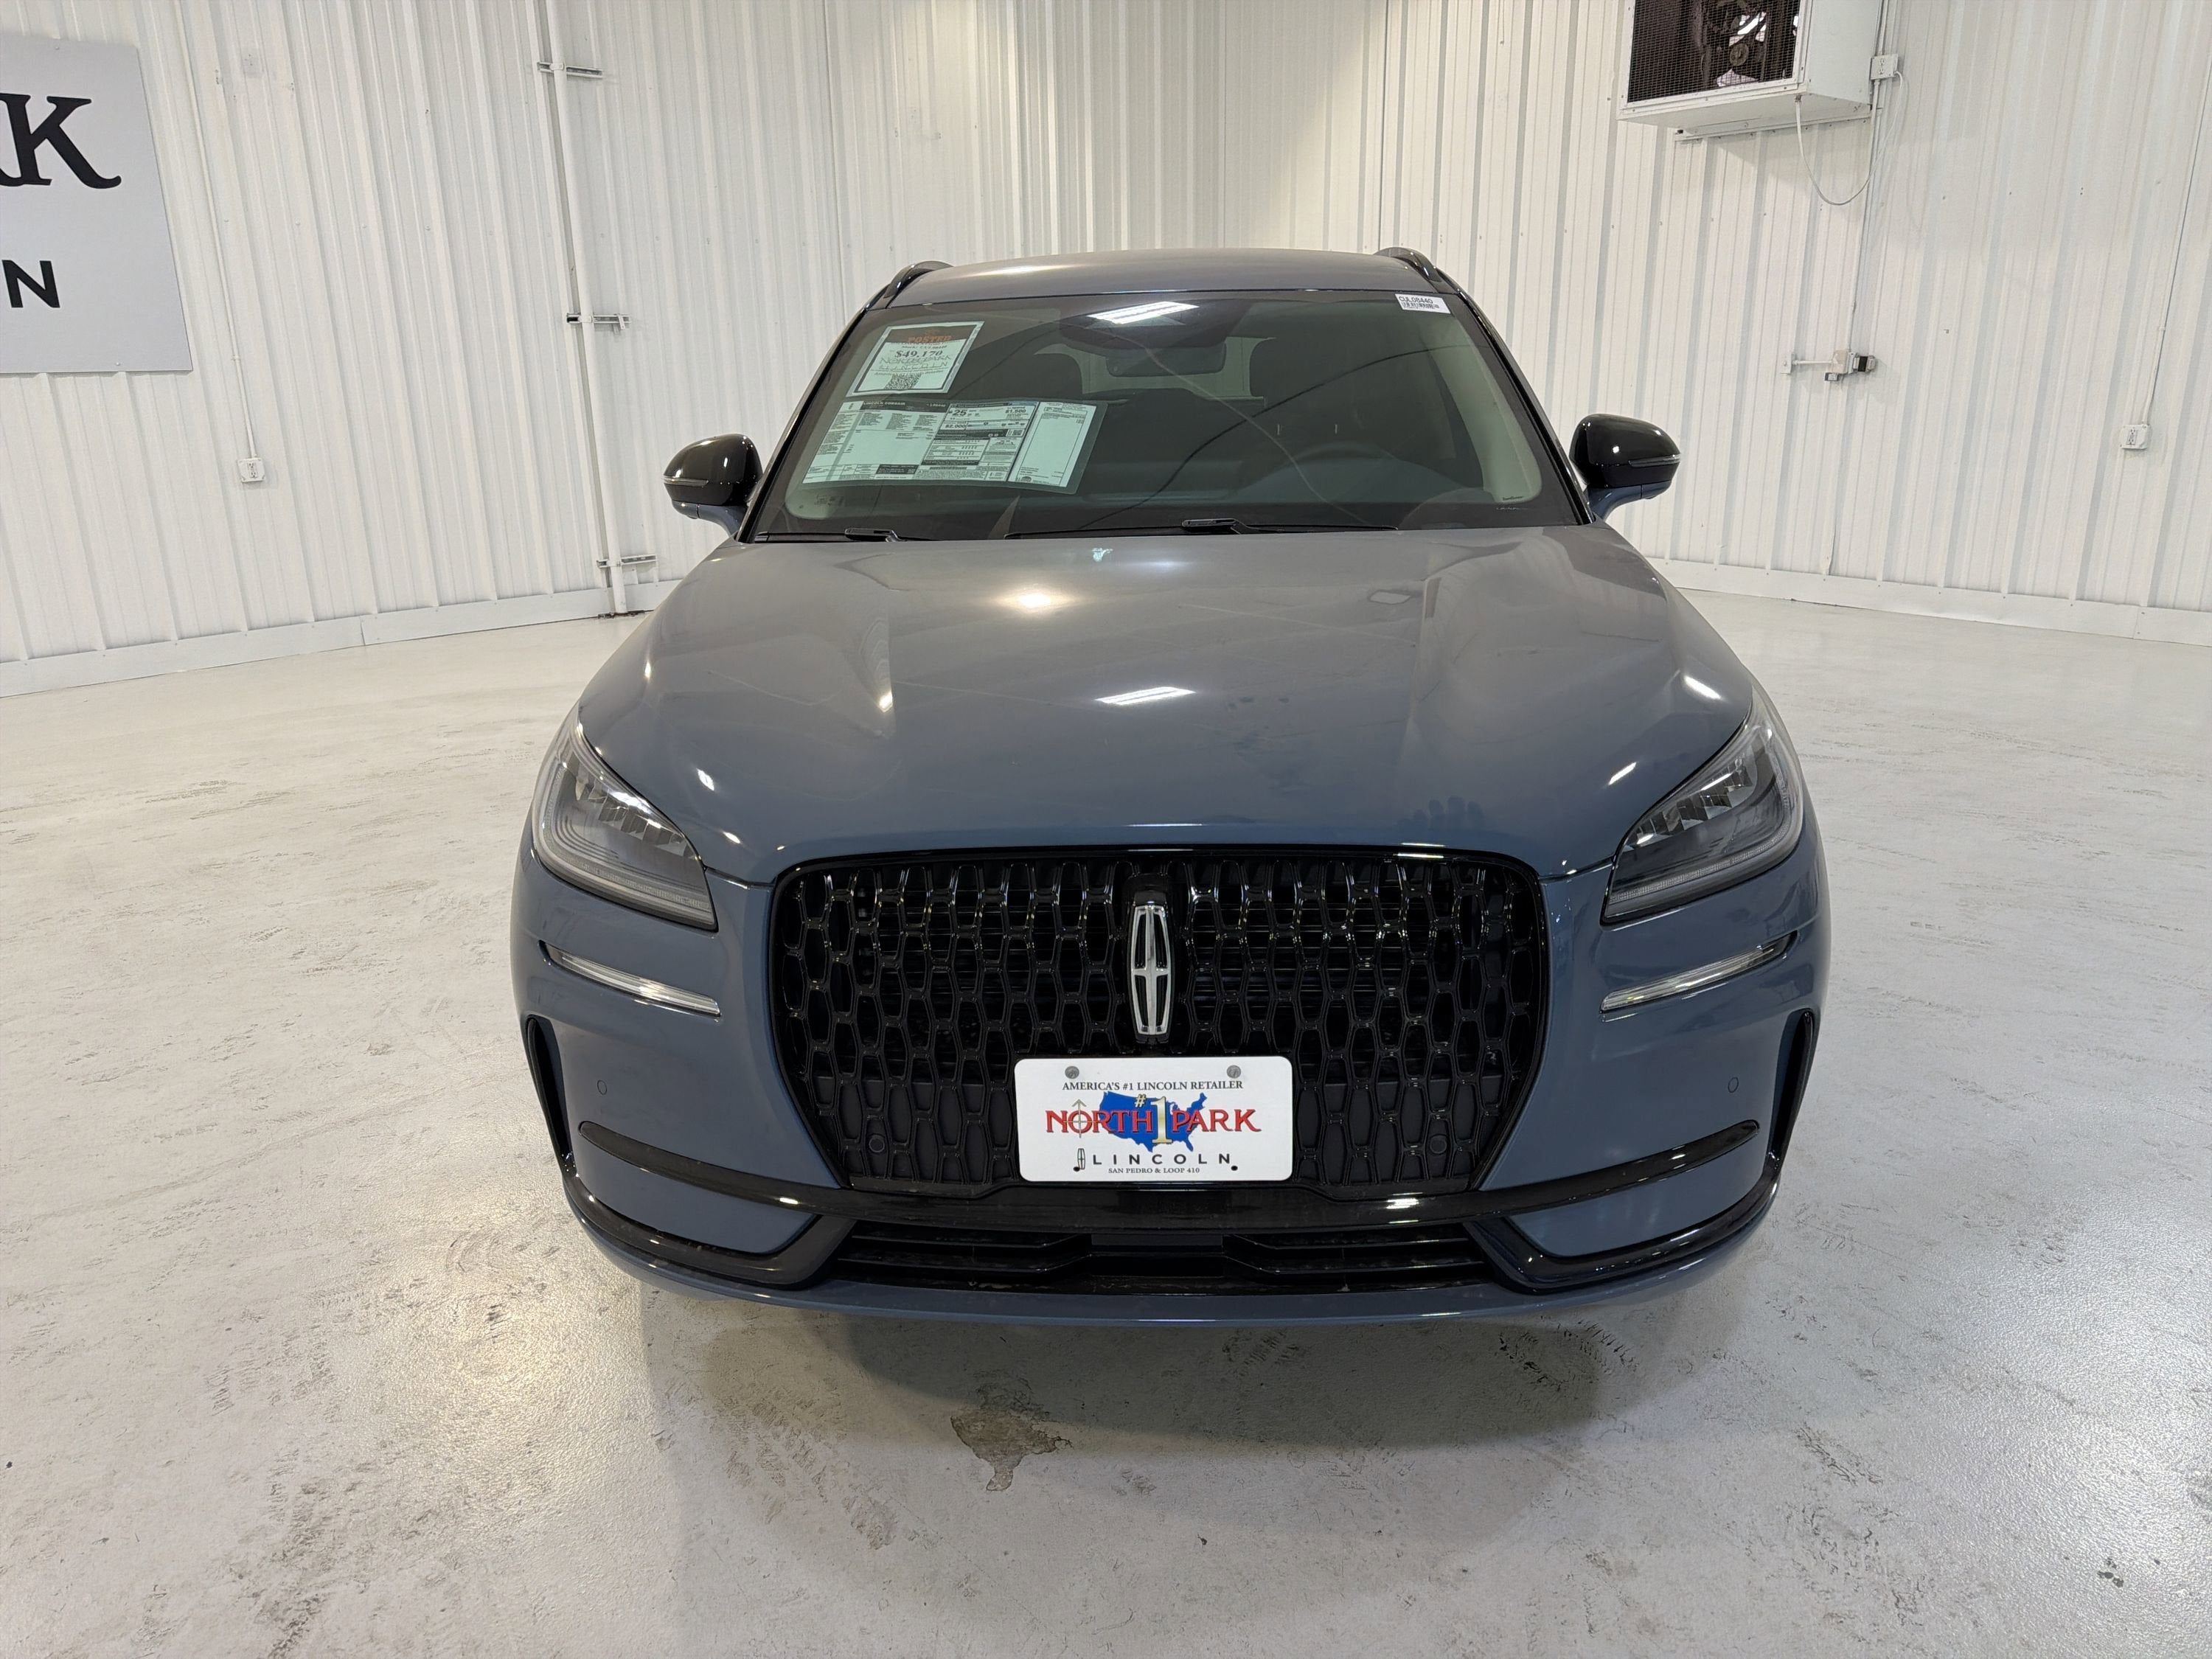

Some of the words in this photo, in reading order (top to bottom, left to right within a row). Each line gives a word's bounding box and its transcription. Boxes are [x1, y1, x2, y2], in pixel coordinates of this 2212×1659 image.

[1062, 1081, 1120, 1091] AMERICA'S
[1123, 1082, 1133, 1091] #1
[1136, 1082, 1187, 1091] LINCOLN
[1191, 1080, 1243, 1090] RETAILER
[1045, 1110, 1152, 1133] NORTH
[1172, 1108, 1262, 1132] PARK
[1093, 1152, 1231, 1165] LINCOLN
